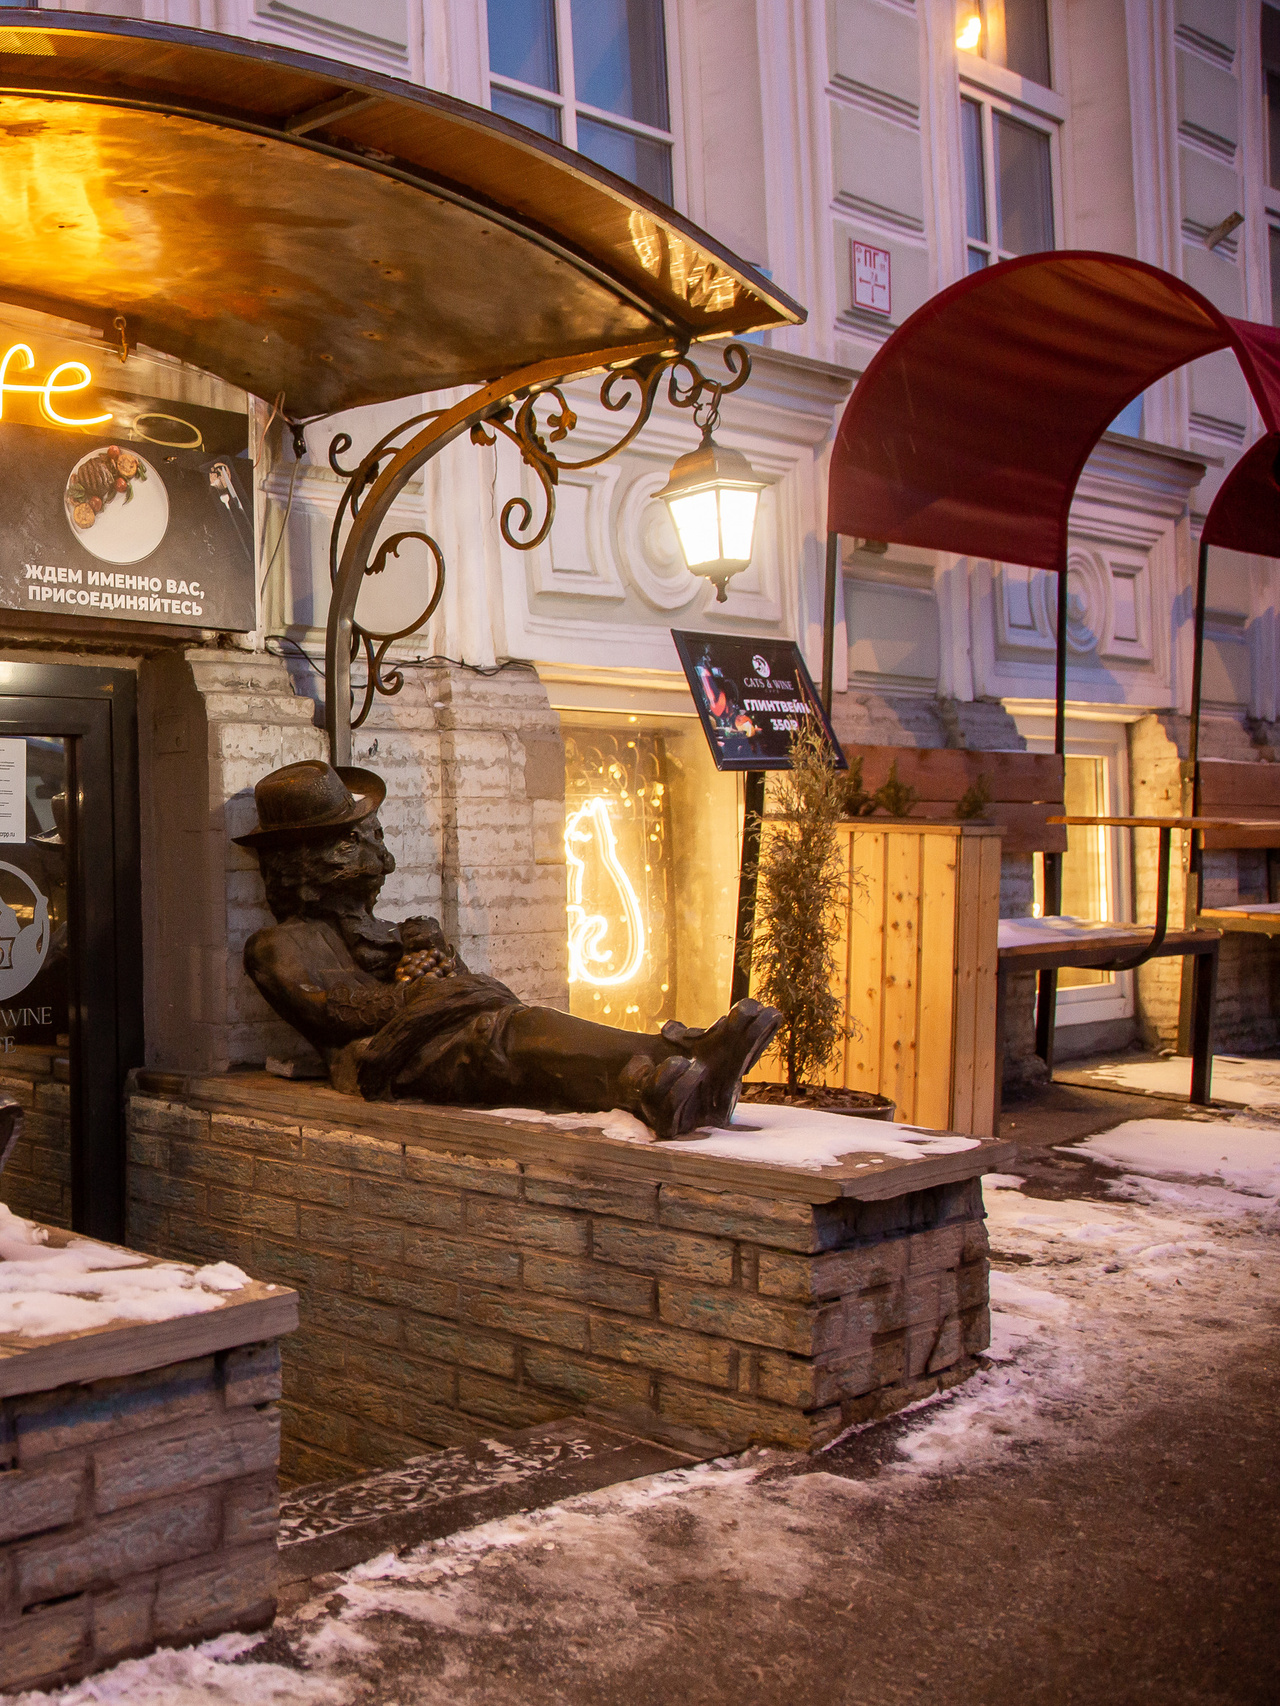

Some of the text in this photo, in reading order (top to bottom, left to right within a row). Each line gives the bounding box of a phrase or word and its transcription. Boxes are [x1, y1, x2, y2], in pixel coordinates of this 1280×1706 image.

[25, 563, 205, 600] ЖДЕМ ИМЕННО ВАС,
[28, 585, 203, 616] ПРИСОЕДИНЯЙТЕСЬ
[743, 677, 765, 688] CATS
[0, 1006, 53, 1027] WINE
